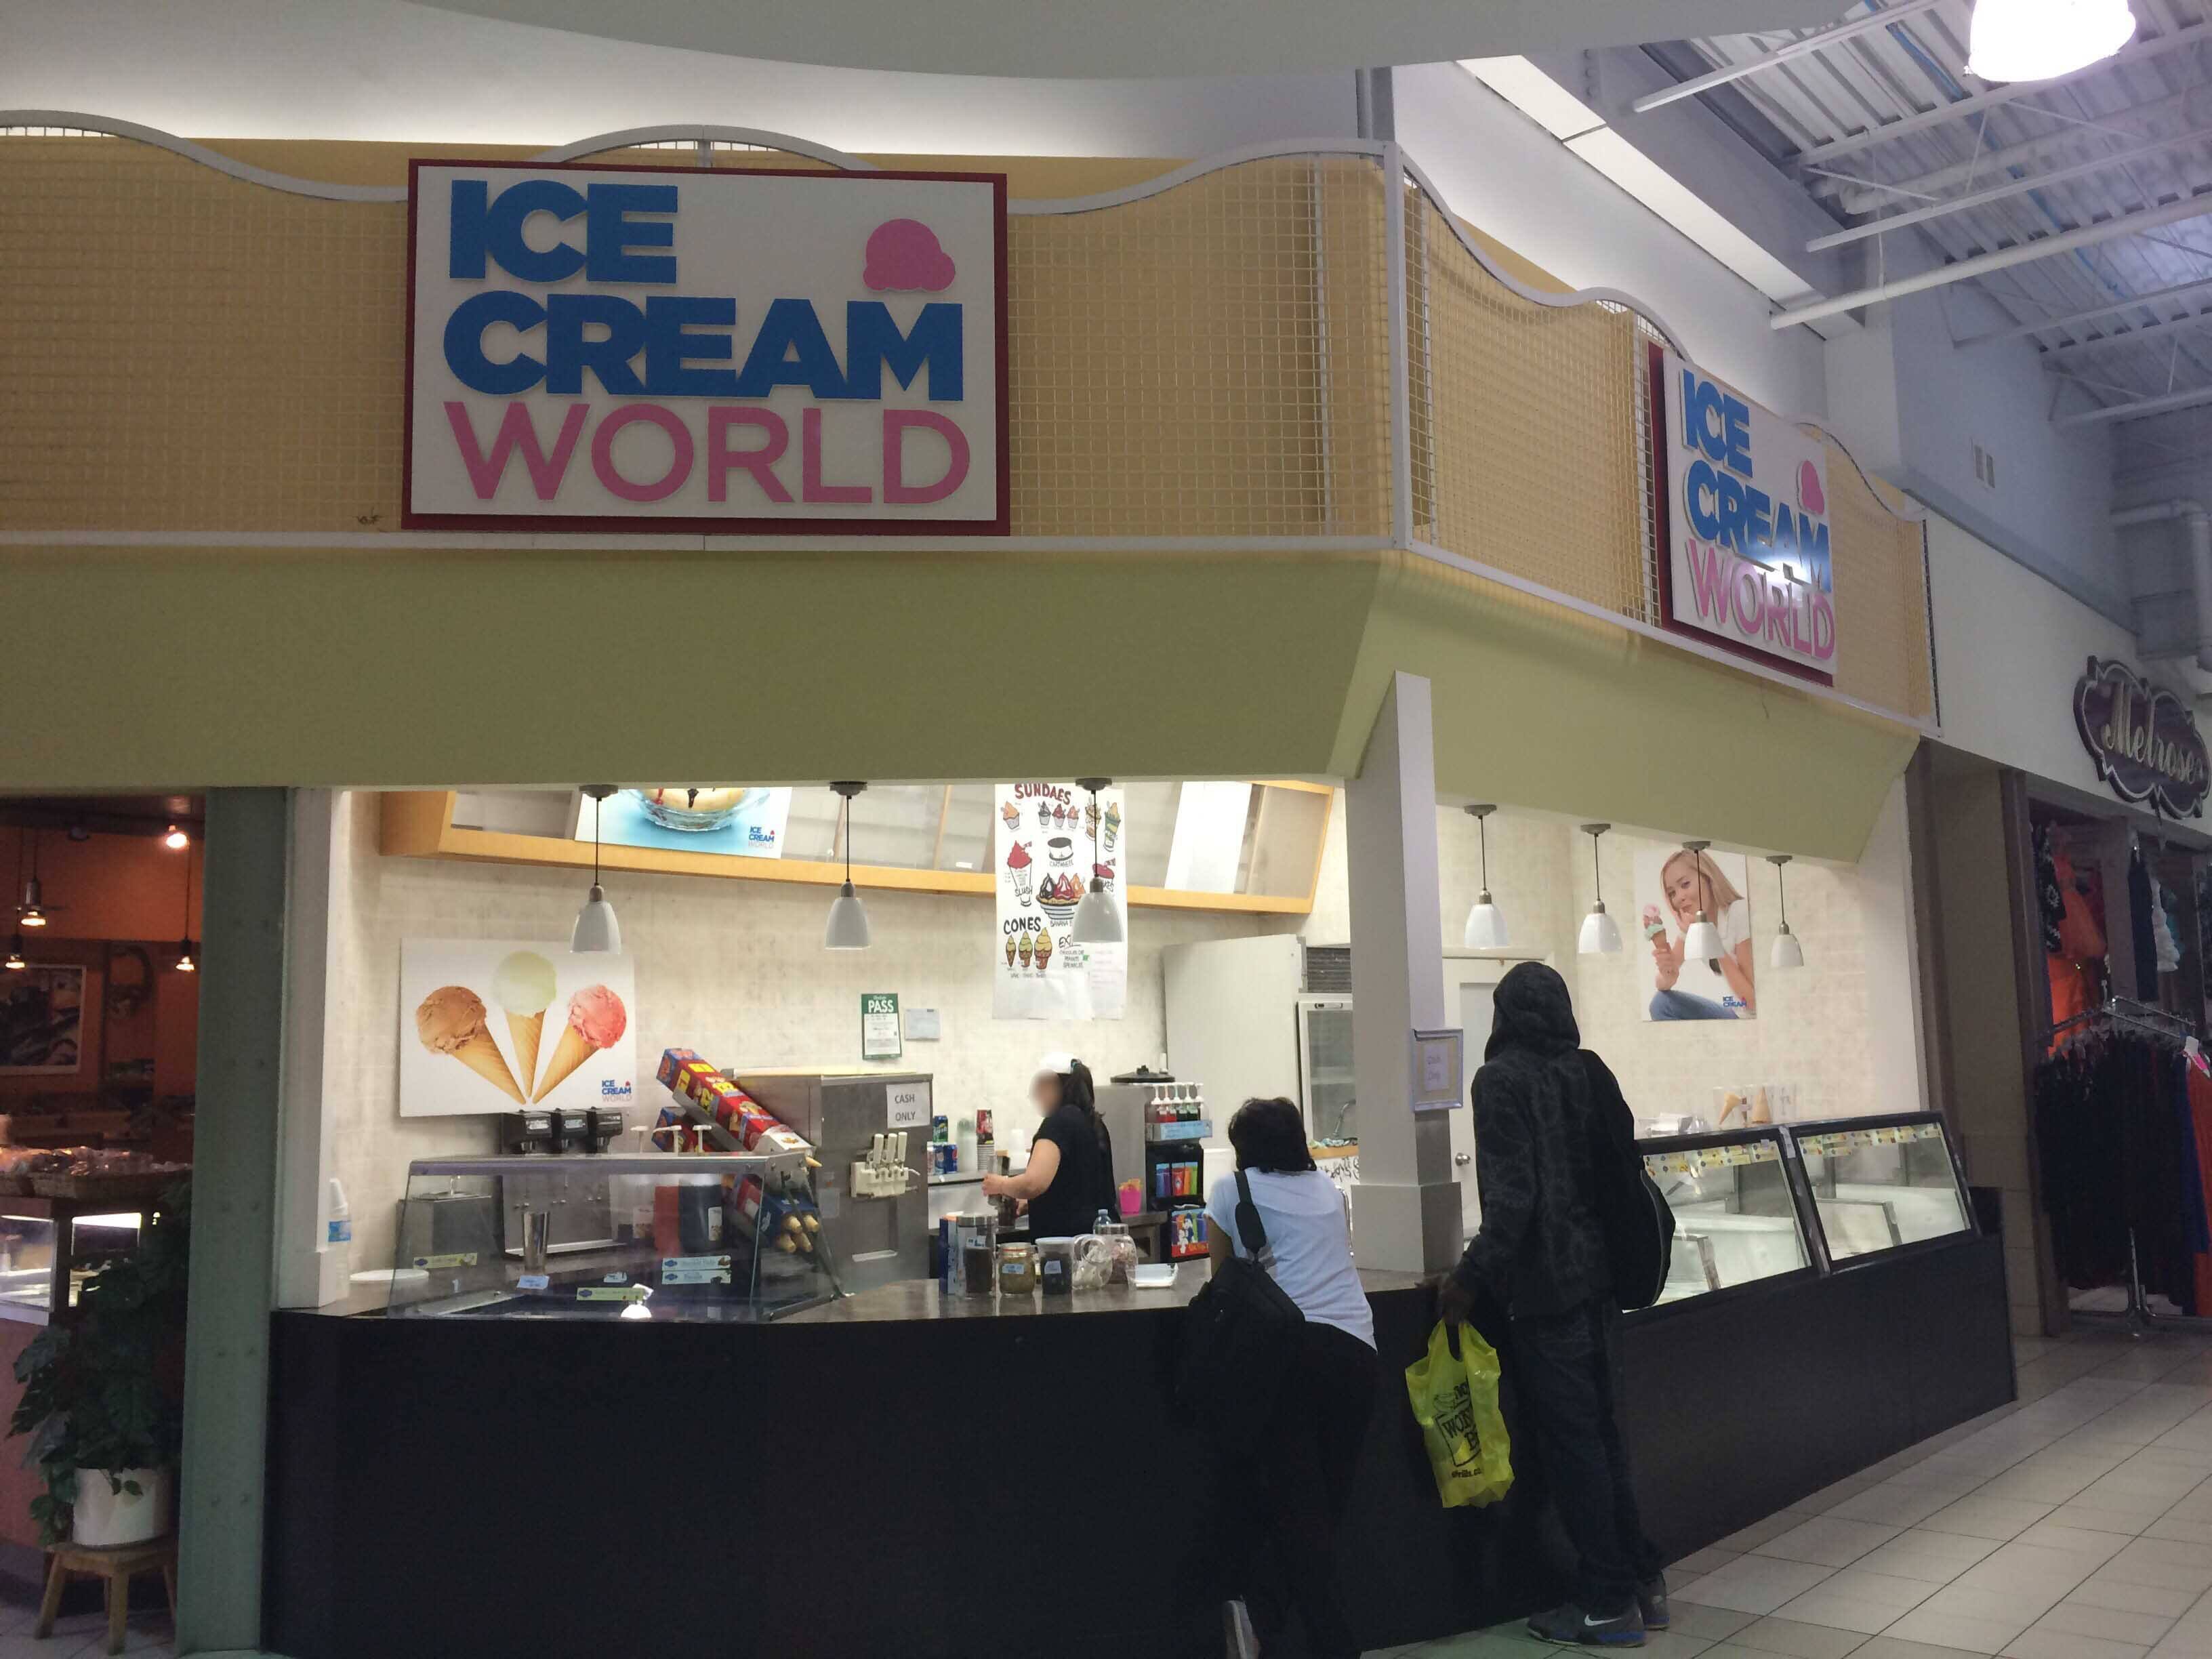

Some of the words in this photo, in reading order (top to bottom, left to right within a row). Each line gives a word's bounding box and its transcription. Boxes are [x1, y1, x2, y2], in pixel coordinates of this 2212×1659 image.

[449, 179, 678, 283] ICE
[443, 290, 964, 401] CREAM
[1683, 368, 1753, 478] ICE
[443, 401, 970, 505] WORLD
[1687, 460, 1831, 593] CREAM
[1689, 537, 1835, 661] WORLD
[1015, 783, 1071, 805] SUNDAES
[750, 825, 762, 834] ICE
[748, 834, 775, 842] CREAM
[1003, 916, 1041, 935] CONES
[868, 1000, 894, 1012] PASS
[601, 1080, 615, 1088] ICE
[601, 1086, 632, 1094] CREAM
[602, 1094, 632, 1102] WORLD
[895, 1094, 915, 1104] CASH
[895, 1111, 916, 1121] ONLY
